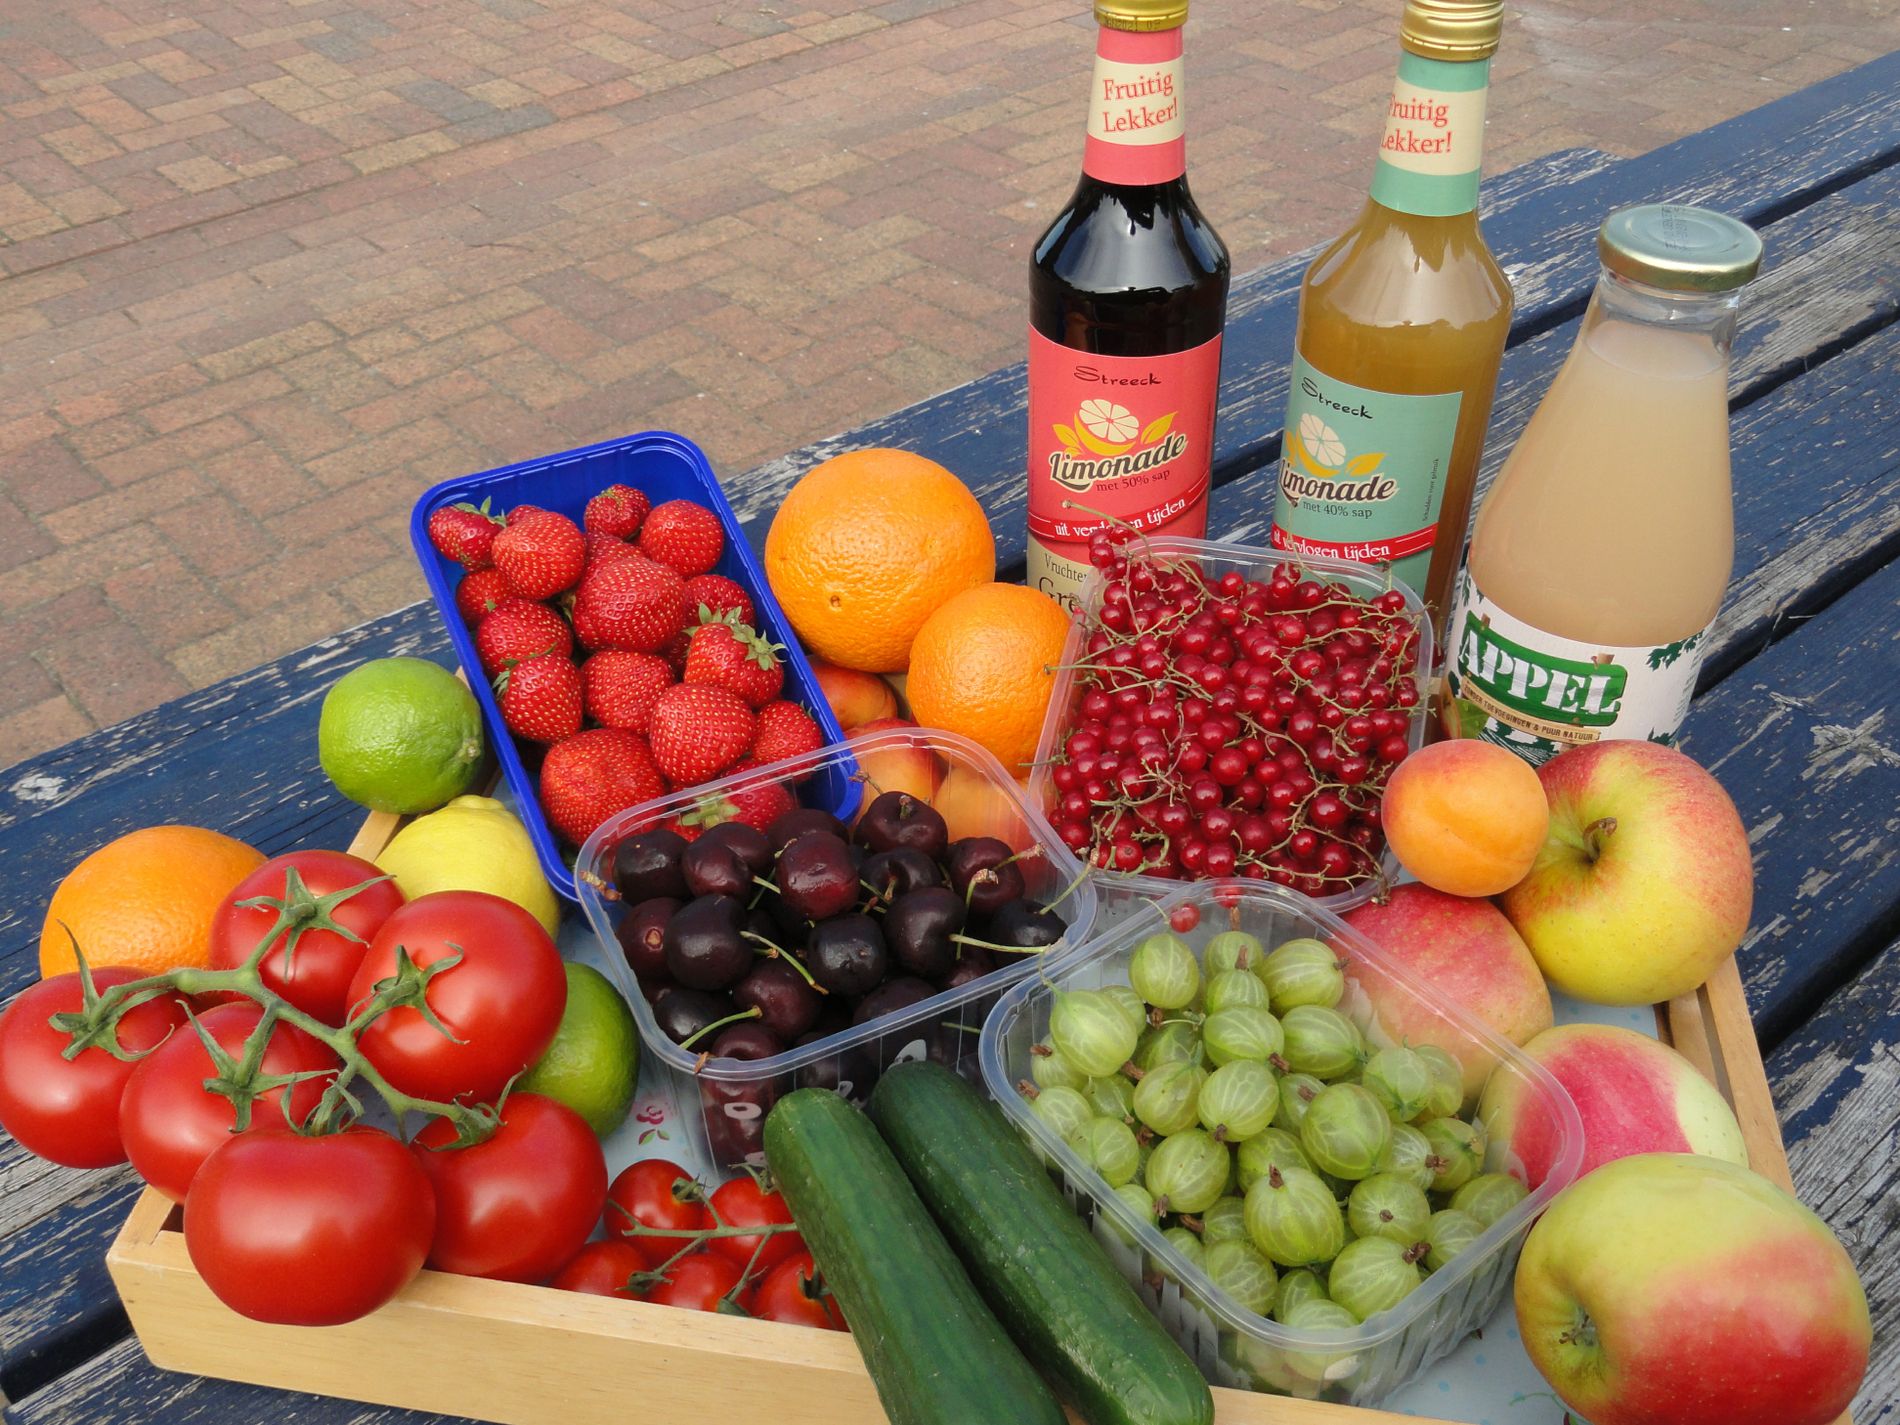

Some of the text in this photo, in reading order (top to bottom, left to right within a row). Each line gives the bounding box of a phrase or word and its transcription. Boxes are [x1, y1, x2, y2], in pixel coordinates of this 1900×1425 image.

[1103, 71, 1174, 101] Fruitig
[1103, 97, 1178, 133] Lekker!
[1073, 365, 1162, 386] Streeck
[1301, 376, 1373, 420] Streeck
[1050, 433, 1186, 491] Limonade
[1096, 469, 1170, 492] met 50% sap
[1055, 521, 1071, 536] uit
[1147, 497, 1186, 526] tijden
[1303, 500, 1373, 519] met 40% sap
[1344, 543, 1391, 563] tijden
[1459, 630, 1621, 715] APPEL
[1541, 727, 1561, 737] PUUR
[1562, 730, 1594, 742] NATUUR
